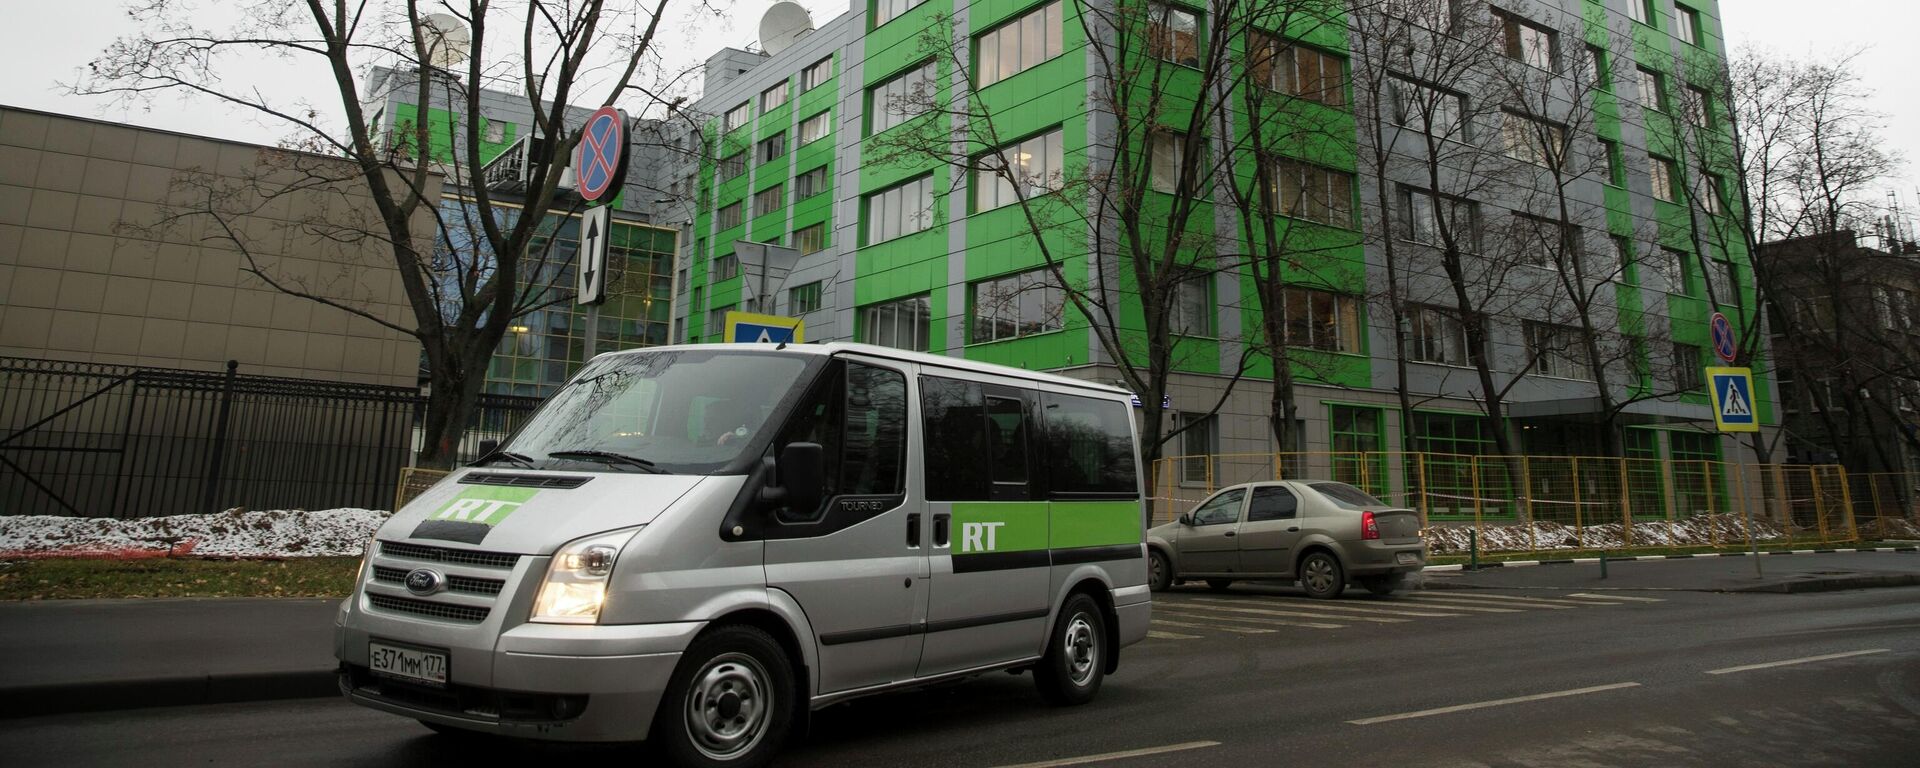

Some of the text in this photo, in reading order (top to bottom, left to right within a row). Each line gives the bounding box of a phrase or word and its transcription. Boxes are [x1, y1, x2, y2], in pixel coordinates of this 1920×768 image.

[438, 499, 522, 522] RT
[841, 501, 883, 511] TOURNEO
[962, 521, 1005, 552] RT
[409, 572, 430, 587] Ford
